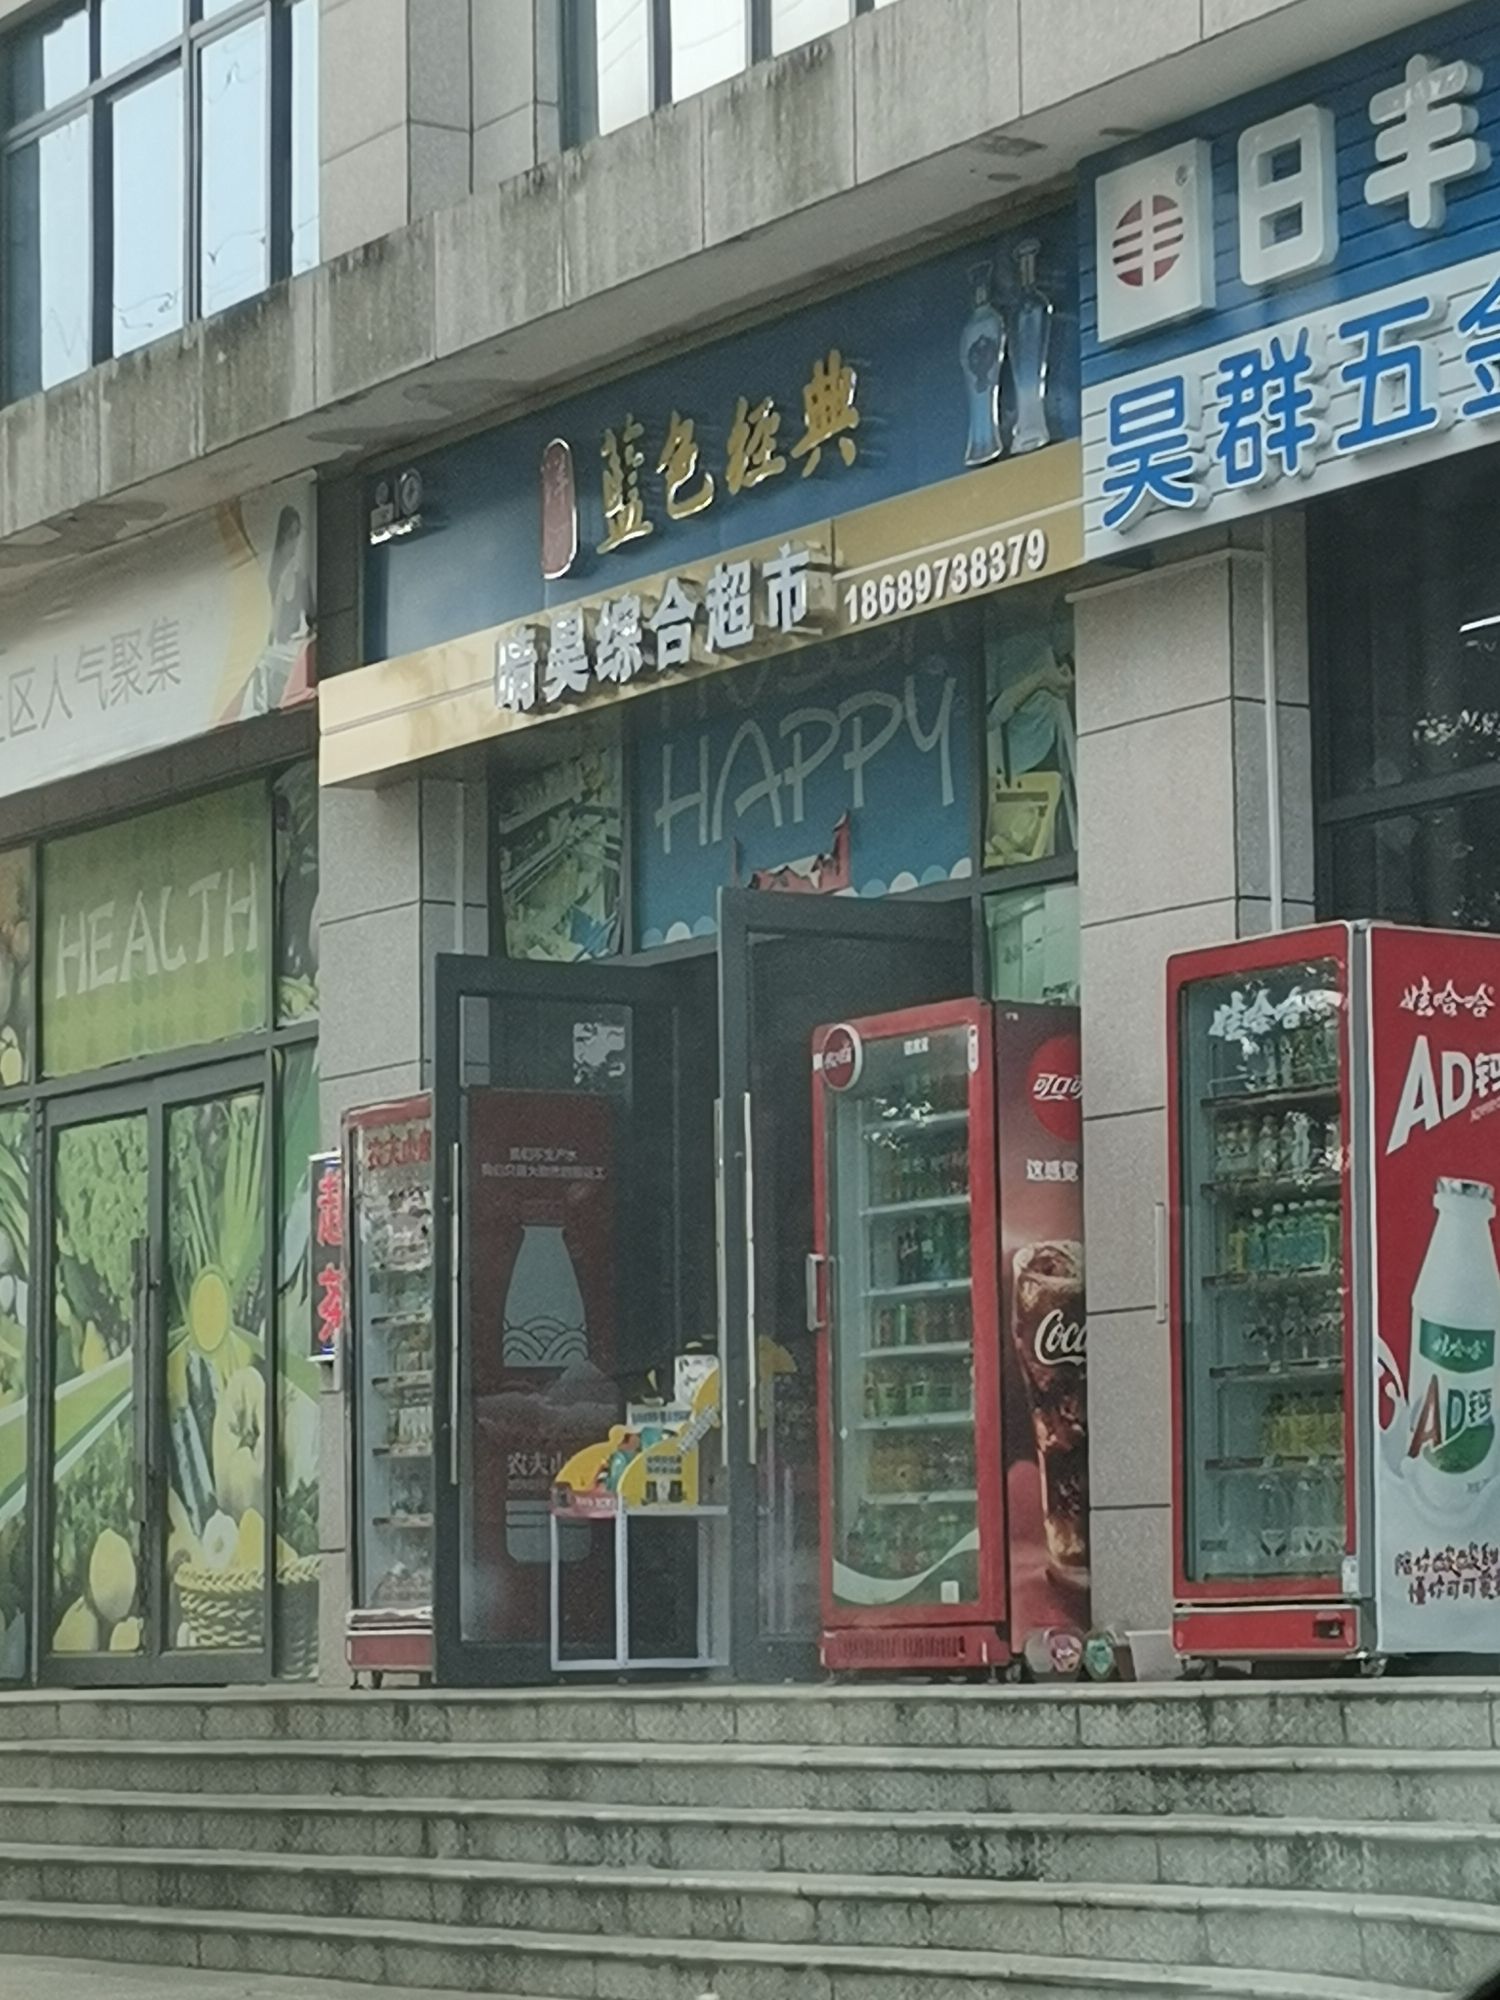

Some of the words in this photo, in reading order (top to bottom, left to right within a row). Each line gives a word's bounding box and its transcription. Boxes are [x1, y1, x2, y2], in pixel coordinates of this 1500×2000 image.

[1238, 54, 1482, 286] 日丰
[844, 528, 1046, 624] 18689738379
[0, 617, 181, 742] 区人气聚集
[654, 676, 957, 854] HAPPY
[55, 862, 258, 999] HEALTH
[1400, 975, 1495, 1018] 娃哈哈
